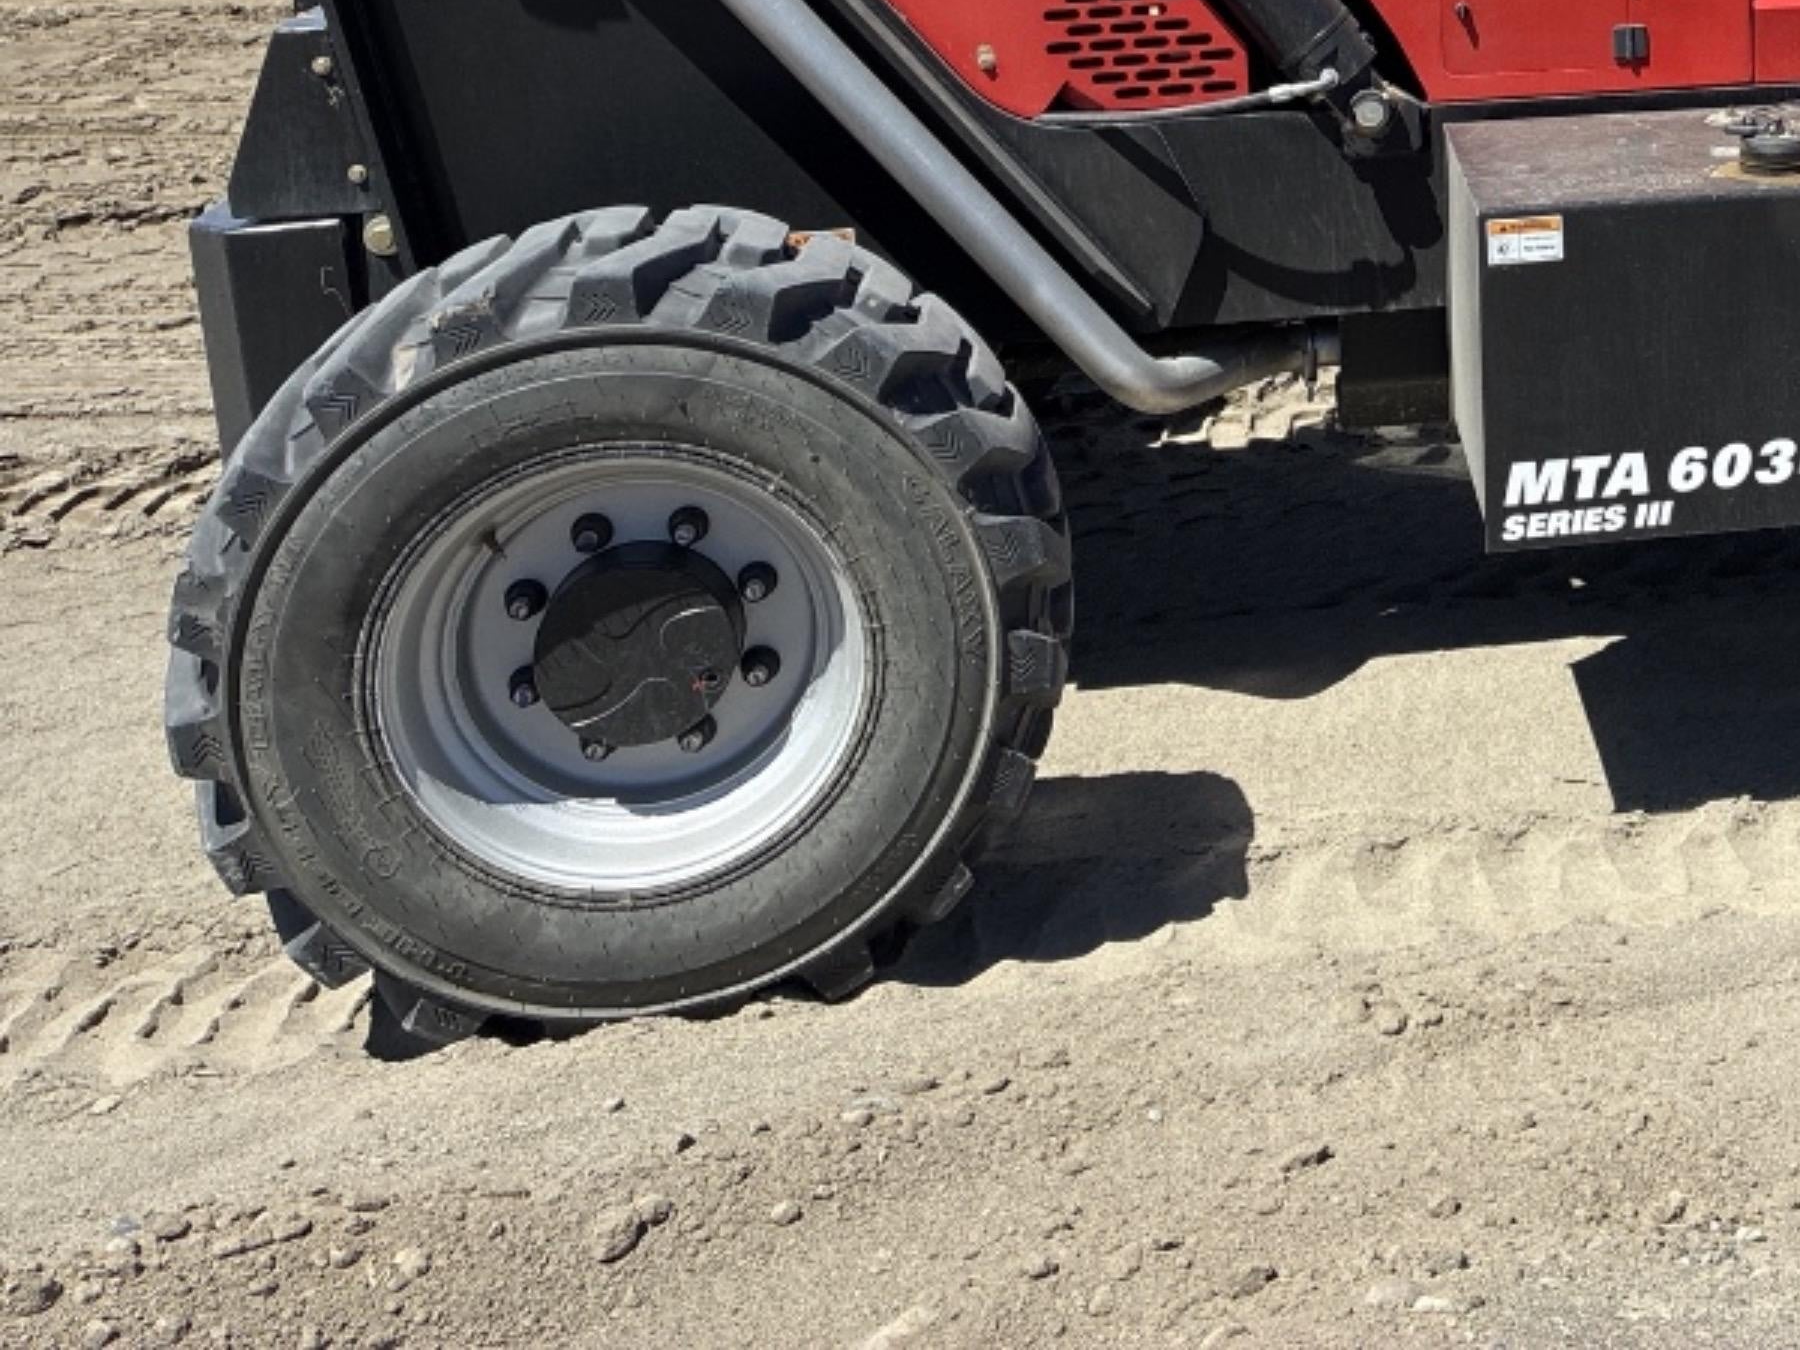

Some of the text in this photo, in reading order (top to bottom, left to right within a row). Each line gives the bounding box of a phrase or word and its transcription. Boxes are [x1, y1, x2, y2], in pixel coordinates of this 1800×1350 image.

[1503, 451, 1650, 507] MTA
[1502, 500, 1675, 541] SERIES III
